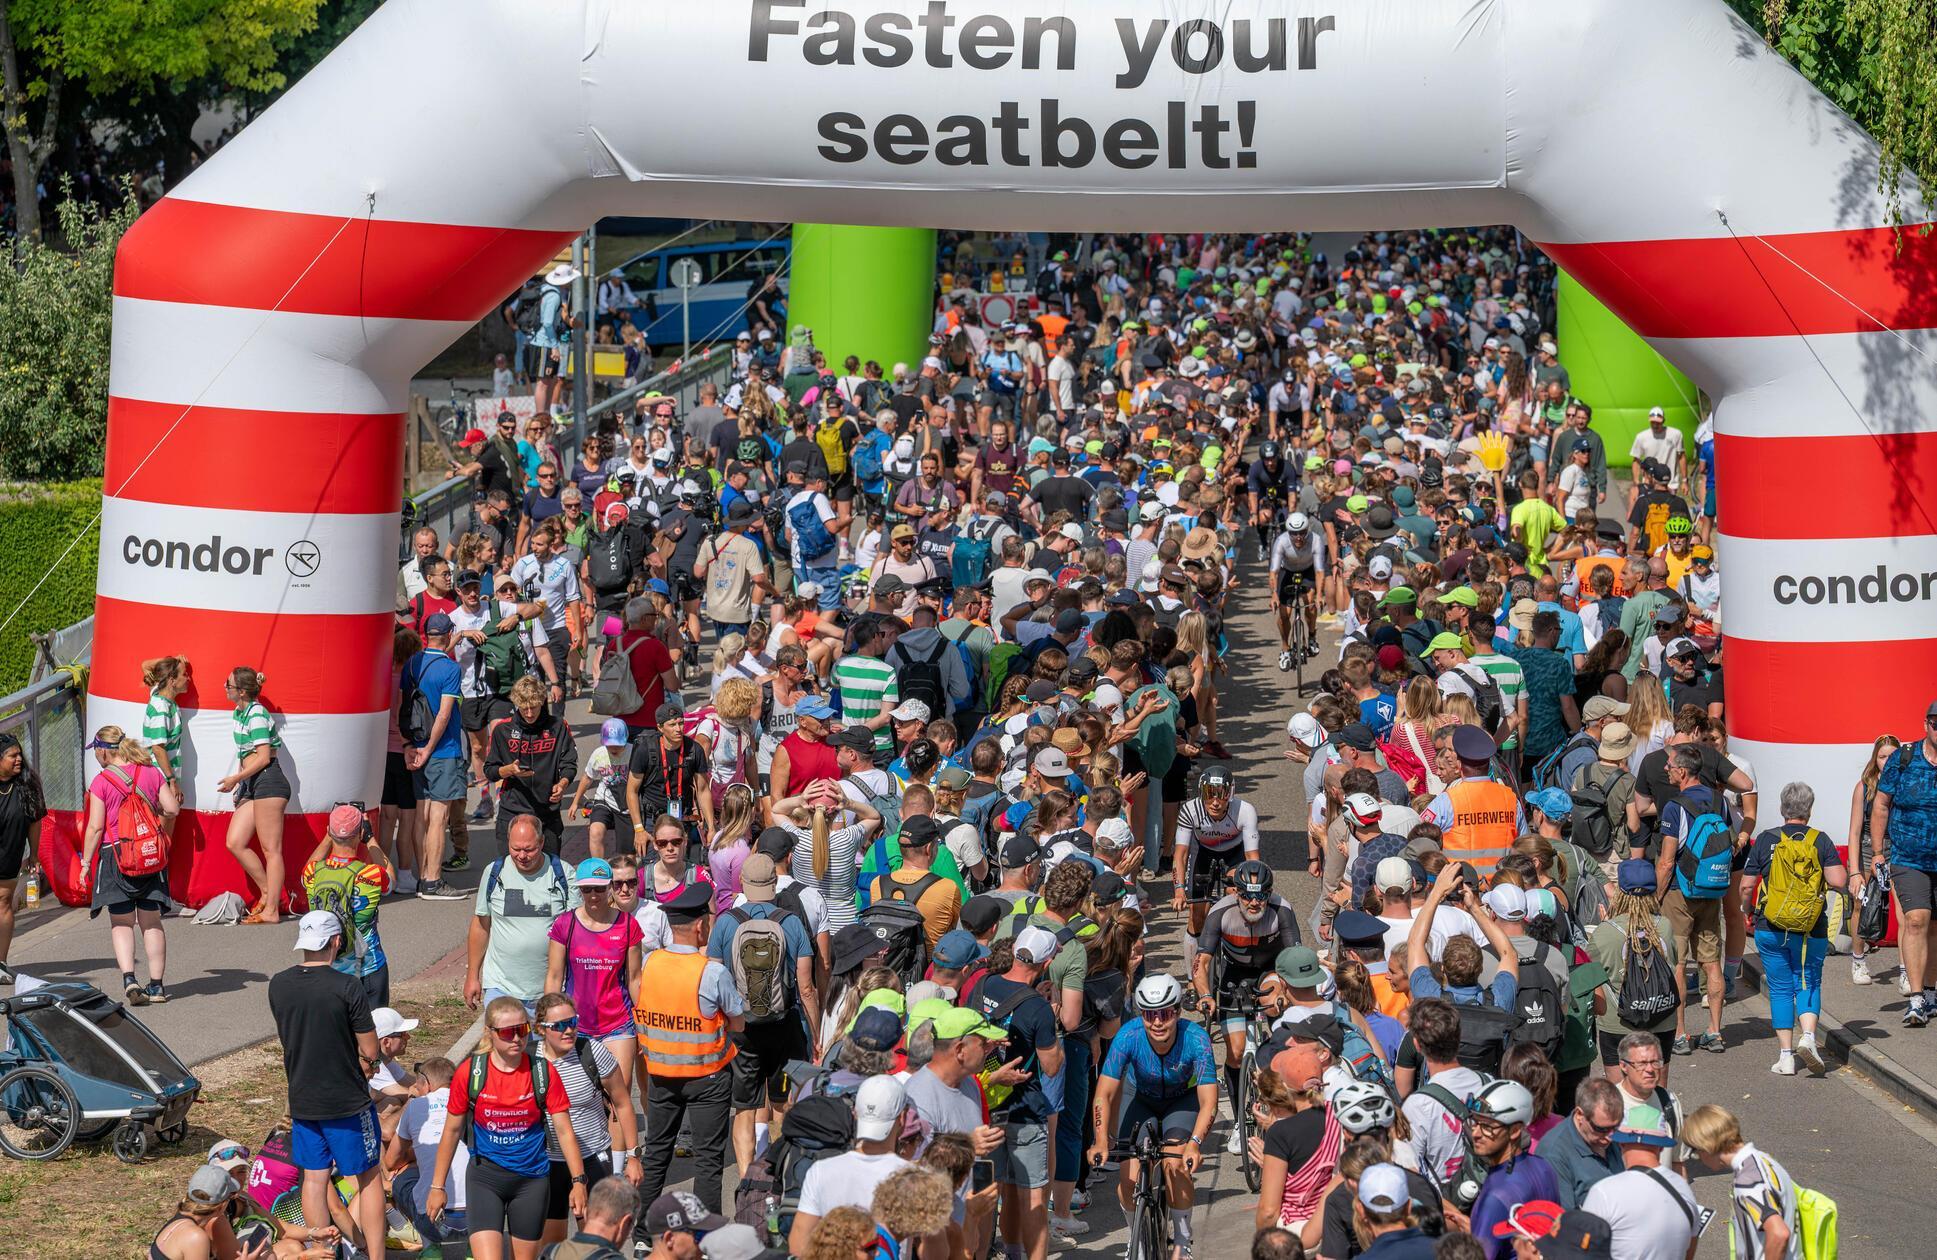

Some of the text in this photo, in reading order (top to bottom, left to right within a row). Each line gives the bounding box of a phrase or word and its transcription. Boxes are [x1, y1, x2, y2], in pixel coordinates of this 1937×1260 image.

[748, 0, 1335, 88] Fasten your
[817, 99, 1257, 168] seatbelt!
[123, 535, 273, 575] condor
[1773, 565, 1937, 605] condor
[1457, 811, 1515, 827] FEUERWEHR
[635, 1009, 702, 1031] FEUERWEHR
[1630, 991, 1675, 1014] sailfish
